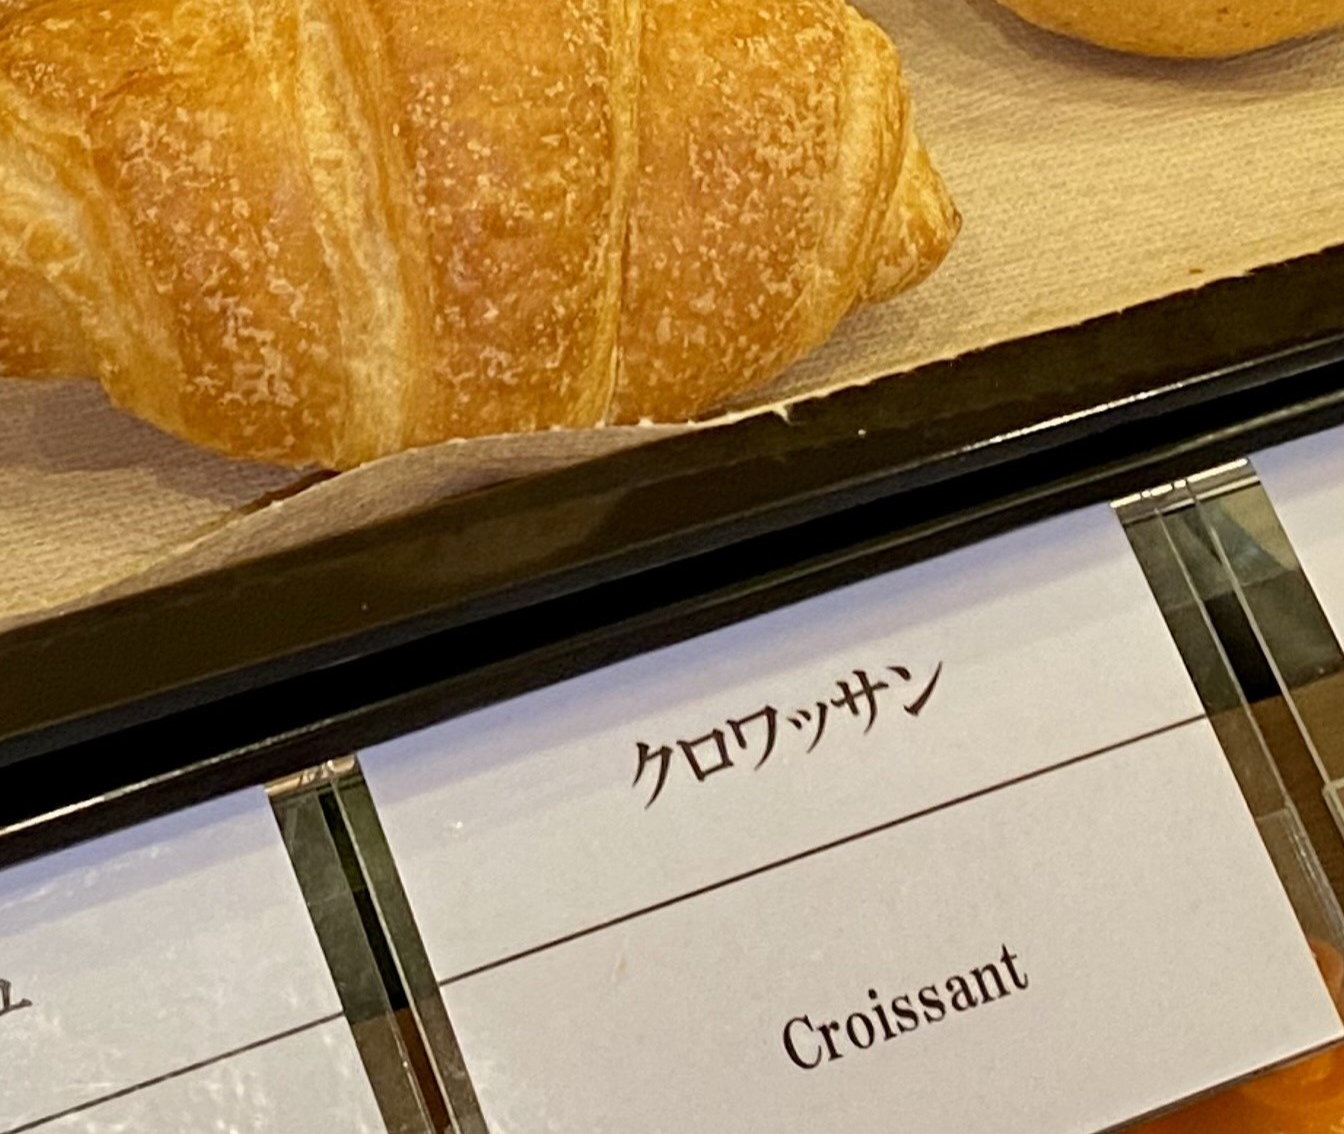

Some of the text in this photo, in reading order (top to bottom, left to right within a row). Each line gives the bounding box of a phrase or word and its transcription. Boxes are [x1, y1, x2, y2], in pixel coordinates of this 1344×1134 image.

[632, 661, 943, 808] クロワッサン
[782, 943, 1030, 1071] Croissant
